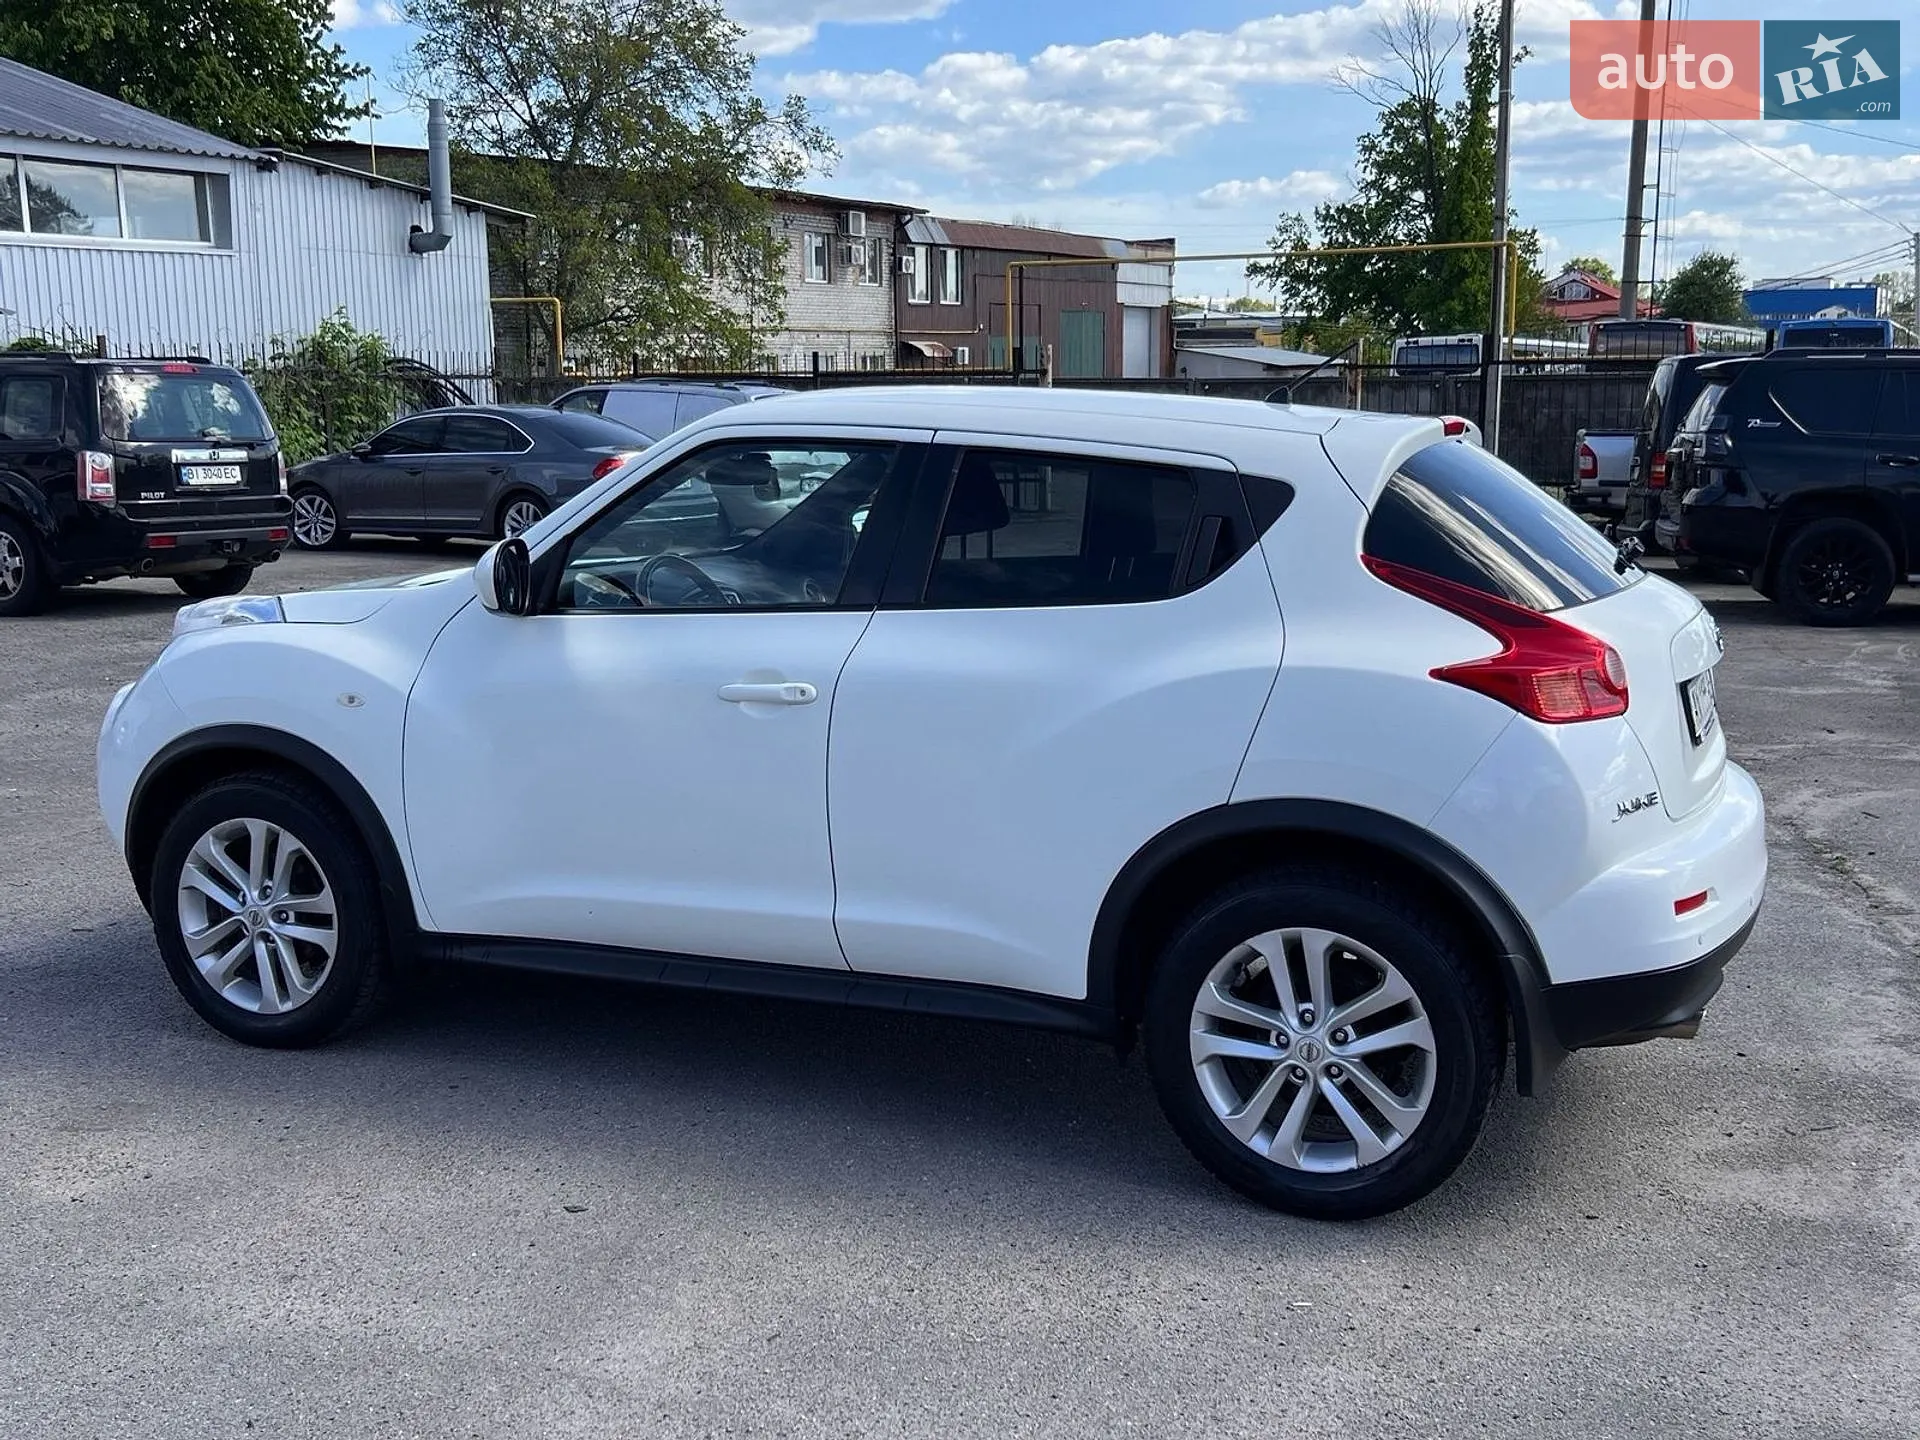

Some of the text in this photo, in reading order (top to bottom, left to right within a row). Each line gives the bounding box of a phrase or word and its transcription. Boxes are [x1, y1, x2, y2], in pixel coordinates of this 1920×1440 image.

[203, 467, 222, 479] 3040
[224, 467, 236, 479] EC
[140, 491, 165, 500] PILOT
